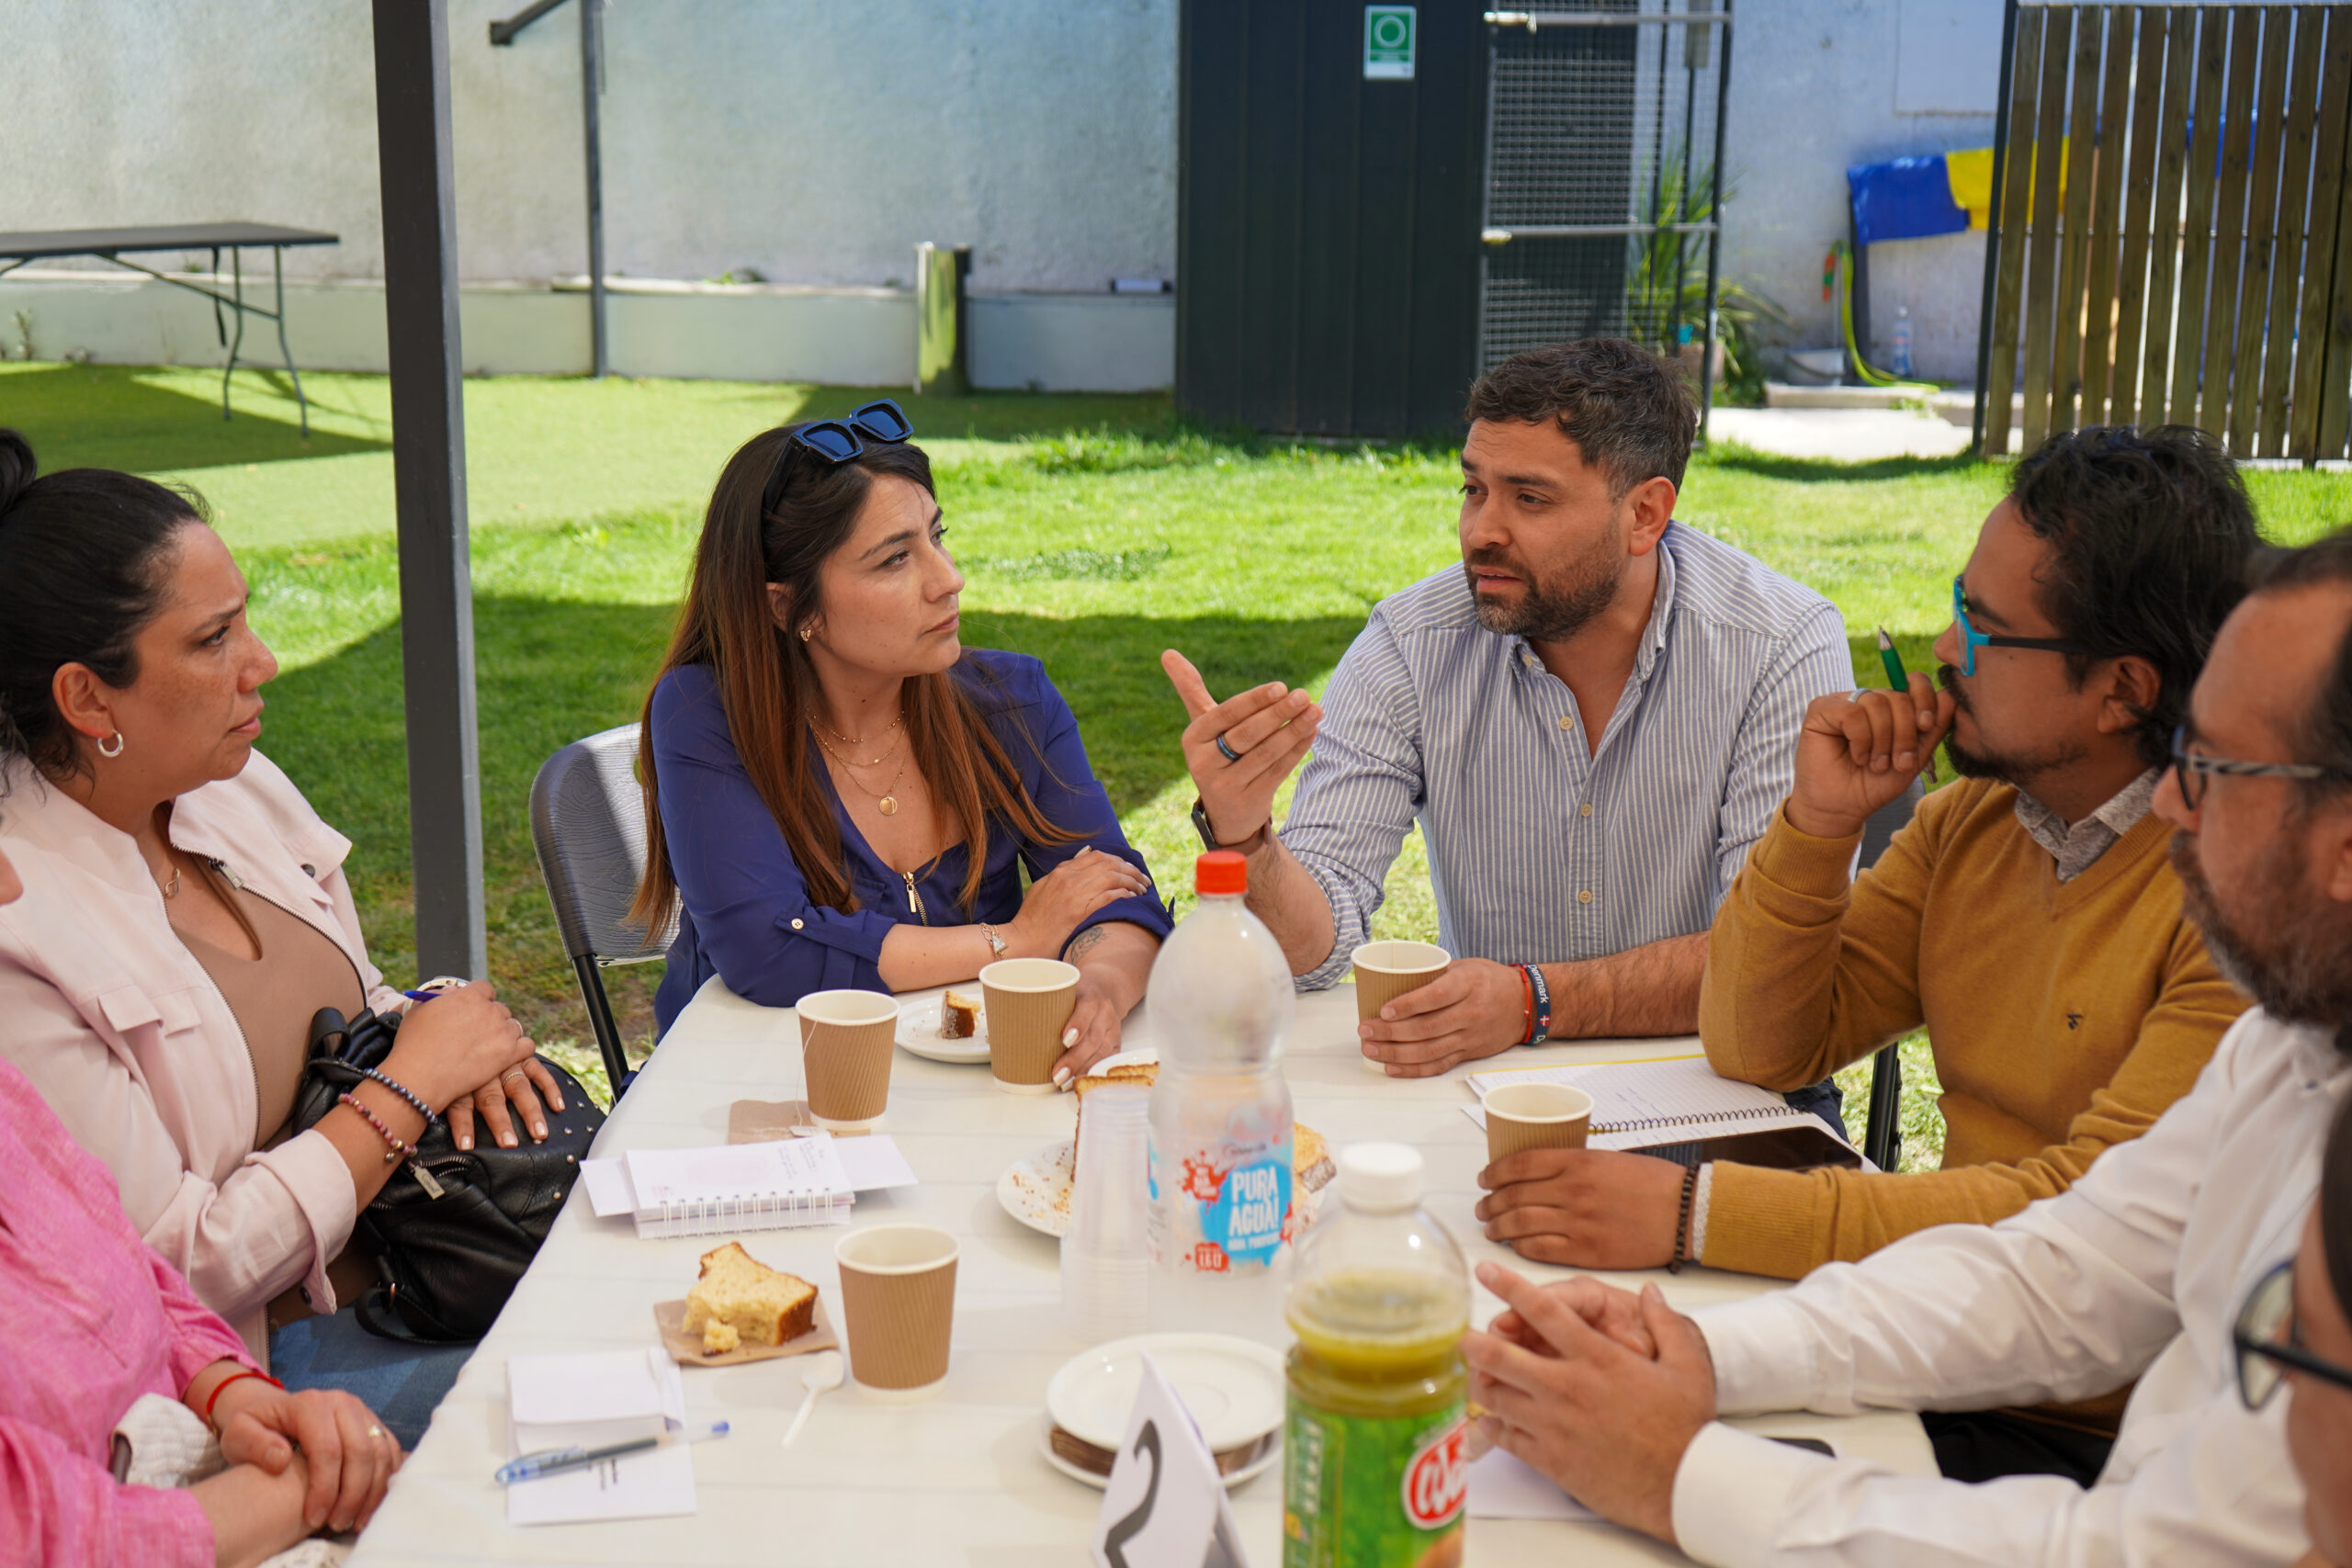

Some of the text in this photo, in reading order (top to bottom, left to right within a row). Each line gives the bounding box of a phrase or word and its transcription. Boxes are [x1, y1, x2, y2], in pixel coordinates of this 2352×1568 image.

[1527, 964, 1549, 1004] Denmark
[1232, 1166, 1279, 1203] PURA
[1229, 1196, 1280, 1237] AGUA!
